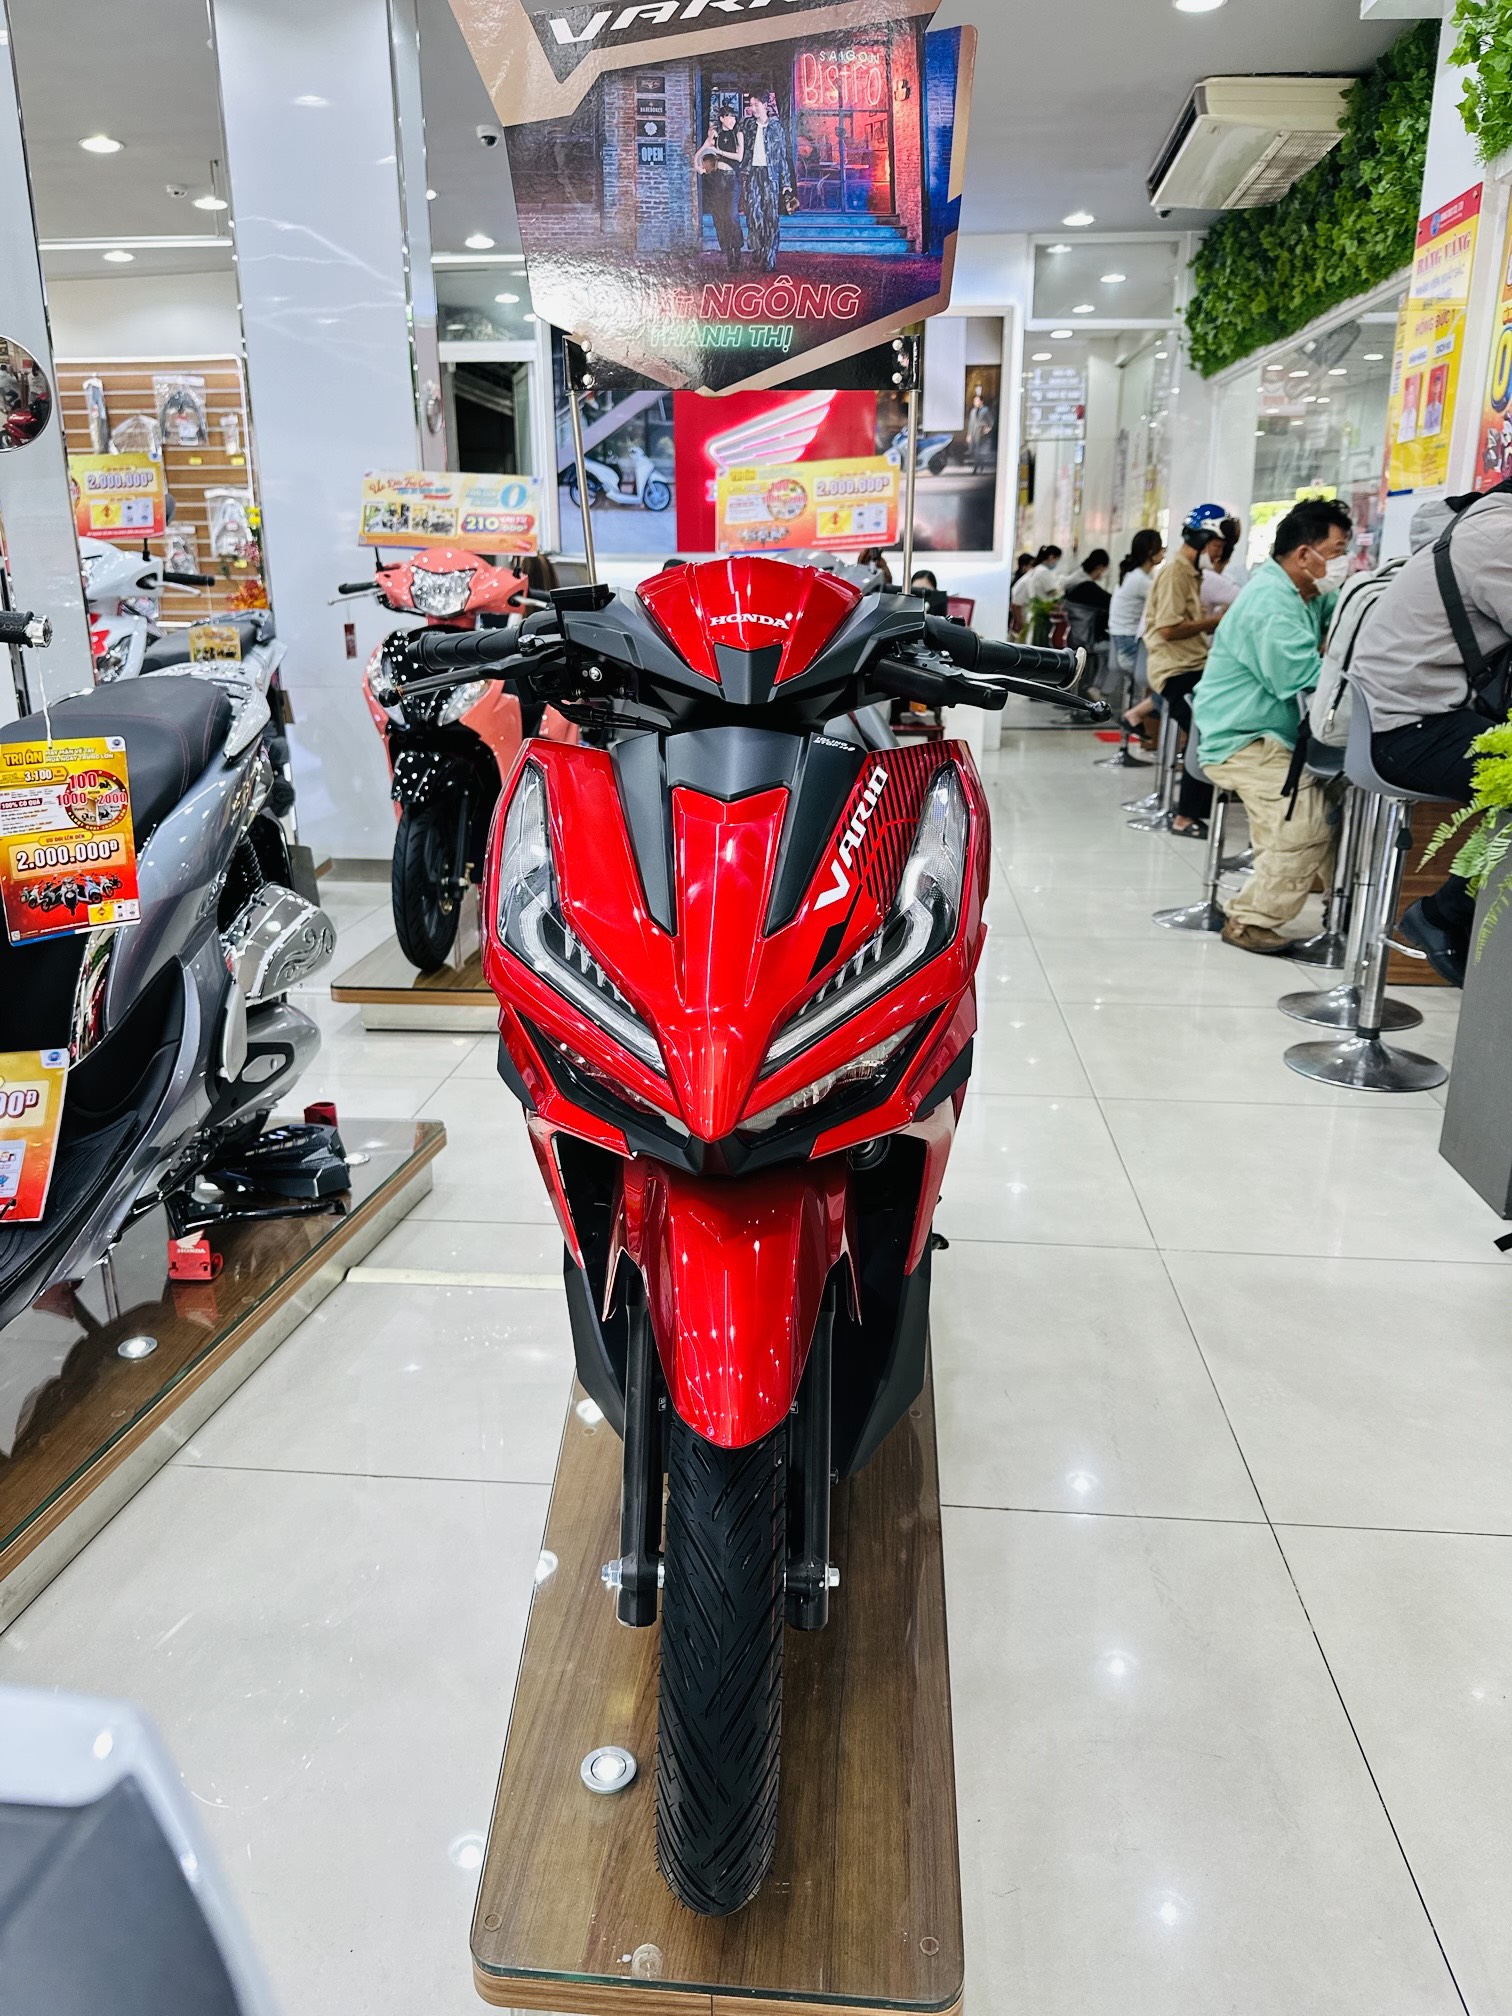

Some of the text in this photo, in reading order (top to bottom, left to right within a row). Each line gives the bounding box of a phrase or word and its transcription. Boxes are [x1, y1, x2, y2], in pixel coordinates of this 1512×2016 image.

[549, 0, 803, 45] VAR
[819, 50, 880, 64] SAIGON
[641, 147, 664, 162] OPEN
[700, 275, 861, 319] NGÔNG
[651, 320, 794, 353] THÀNH THỊ
[465, 516, 499, 532] 210
[710, 613, 790, 630] HONDA
[4, 752, 23, 766] TRI
[25, 749, 43, 765] ÂN
[24, 769, 53, 783] 3.100
[69, 772, 98, 790] 100
[56, 792, 87, 806] 1000
[98, 791, 127, 805] 2000
[813, 765, 888, 911] VARIO
